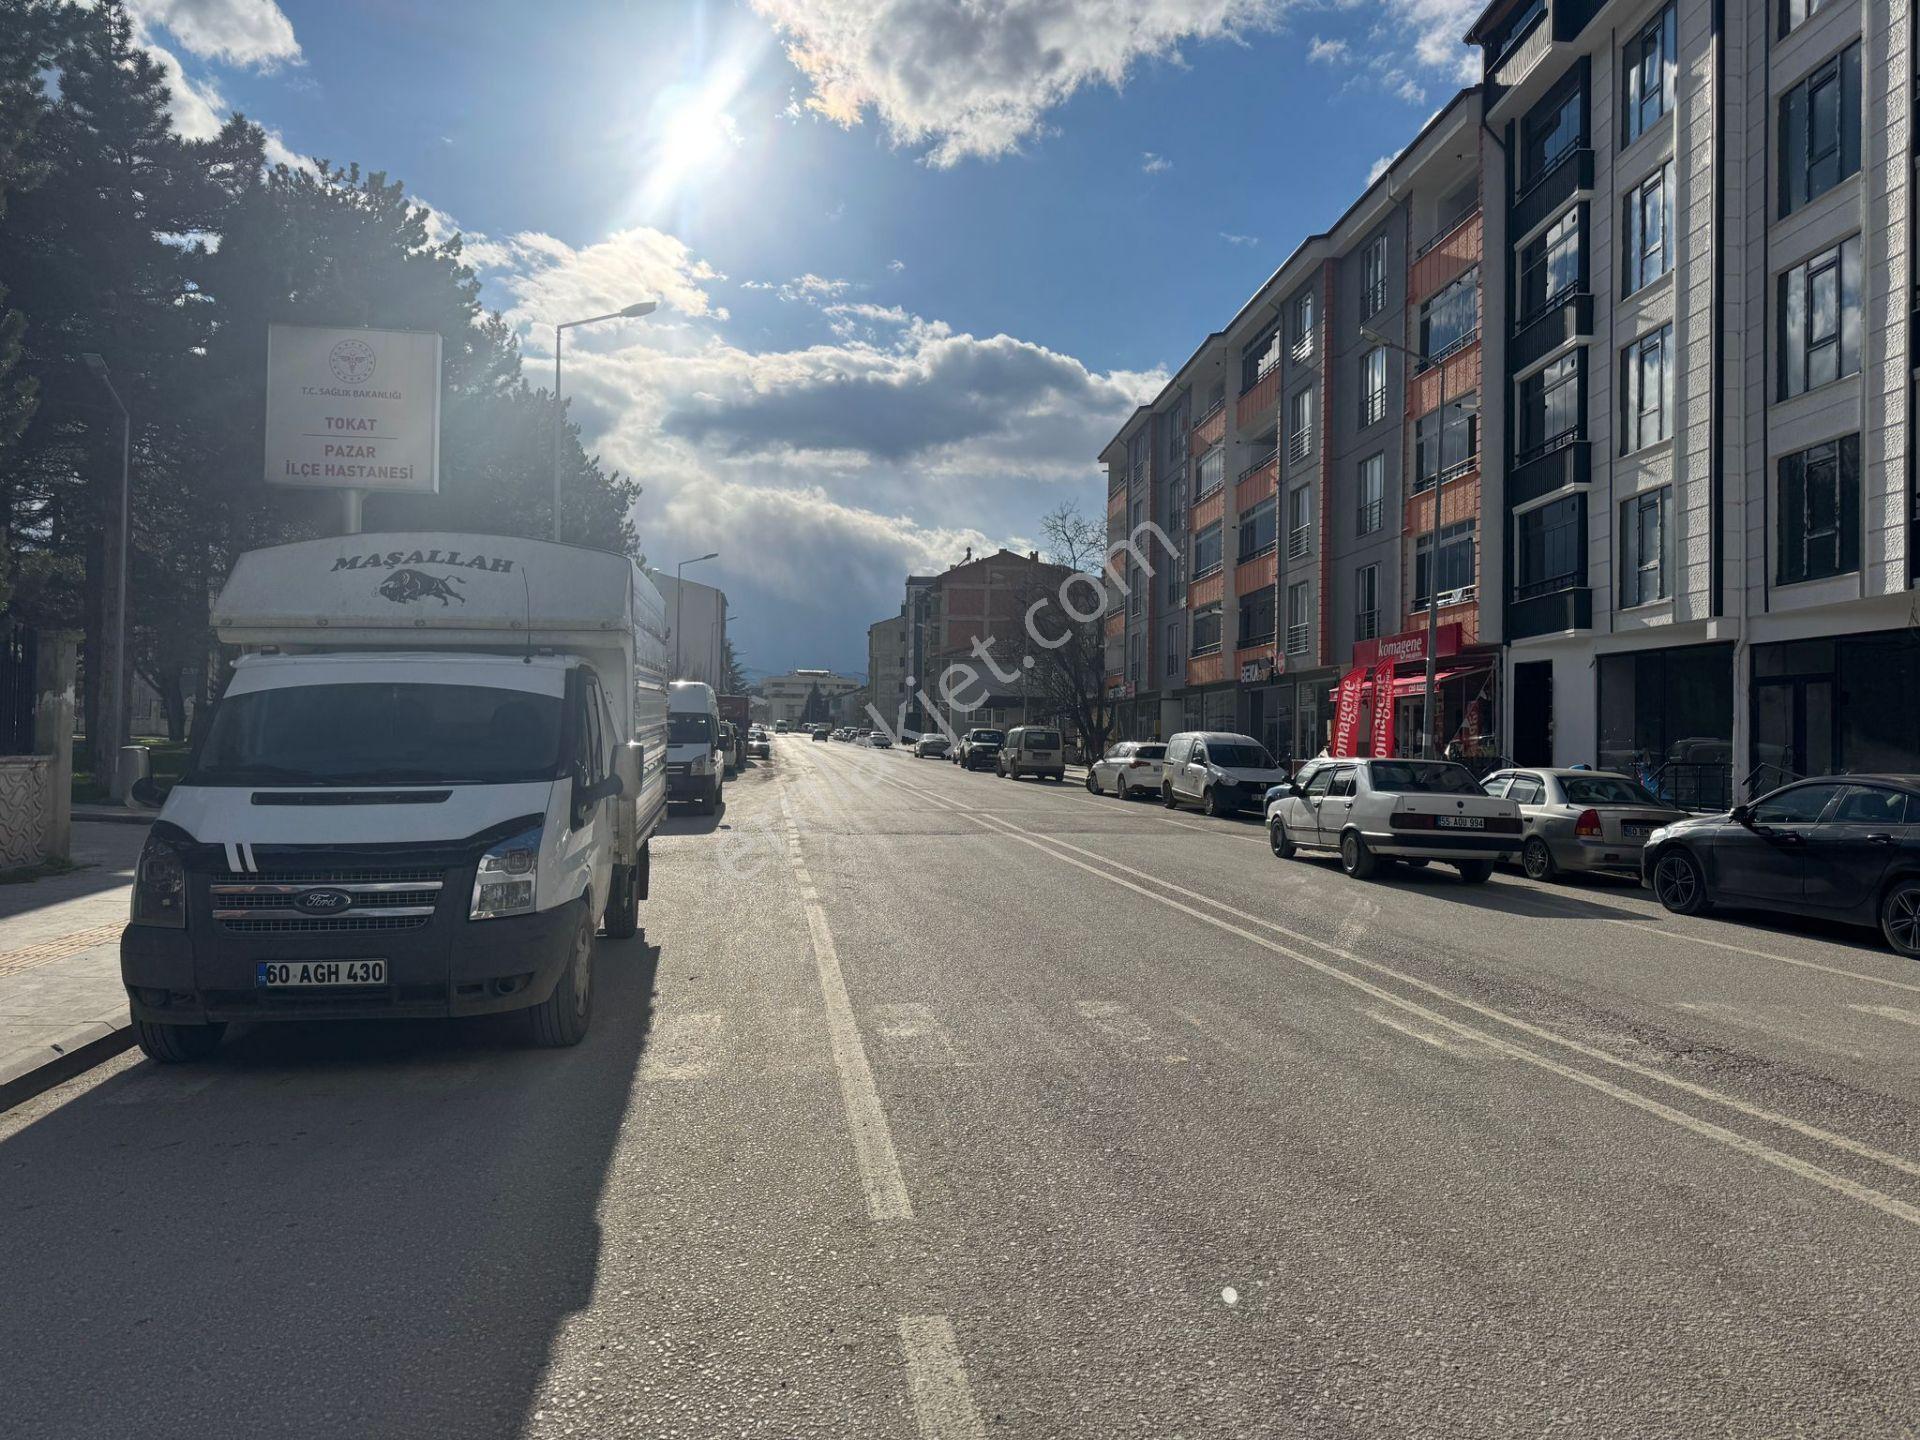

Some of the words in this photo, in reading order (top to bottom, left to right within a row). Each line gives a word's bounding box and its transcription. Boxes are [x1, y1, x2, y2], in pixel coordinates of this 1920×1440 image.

[302, 387, 318, 396] T.C.
[319, 387, 351, 398] SAĞLIK
[353, 390, 402, 400] BAKANLIĞI
[325, 417, 377, 431] TOKAT
[325, 445, 376, 459] PAZAR
[286, 460, 320, 478] İLÇE
[325, 464, 413, 480] HASTANESİ
[330, 550, 515, 573] MAŞALLAH
[1378, 638, 1422, 659] komagene
[1336, 680, 1356, 758] omagene
[1375, 674, 1391, 758] omagene
[307, 893, 337, 907] Ford
[266, 964, 290, 984] 60
[299, 963, 339, 984] AGH
[347, 962, 383, 981] 430
